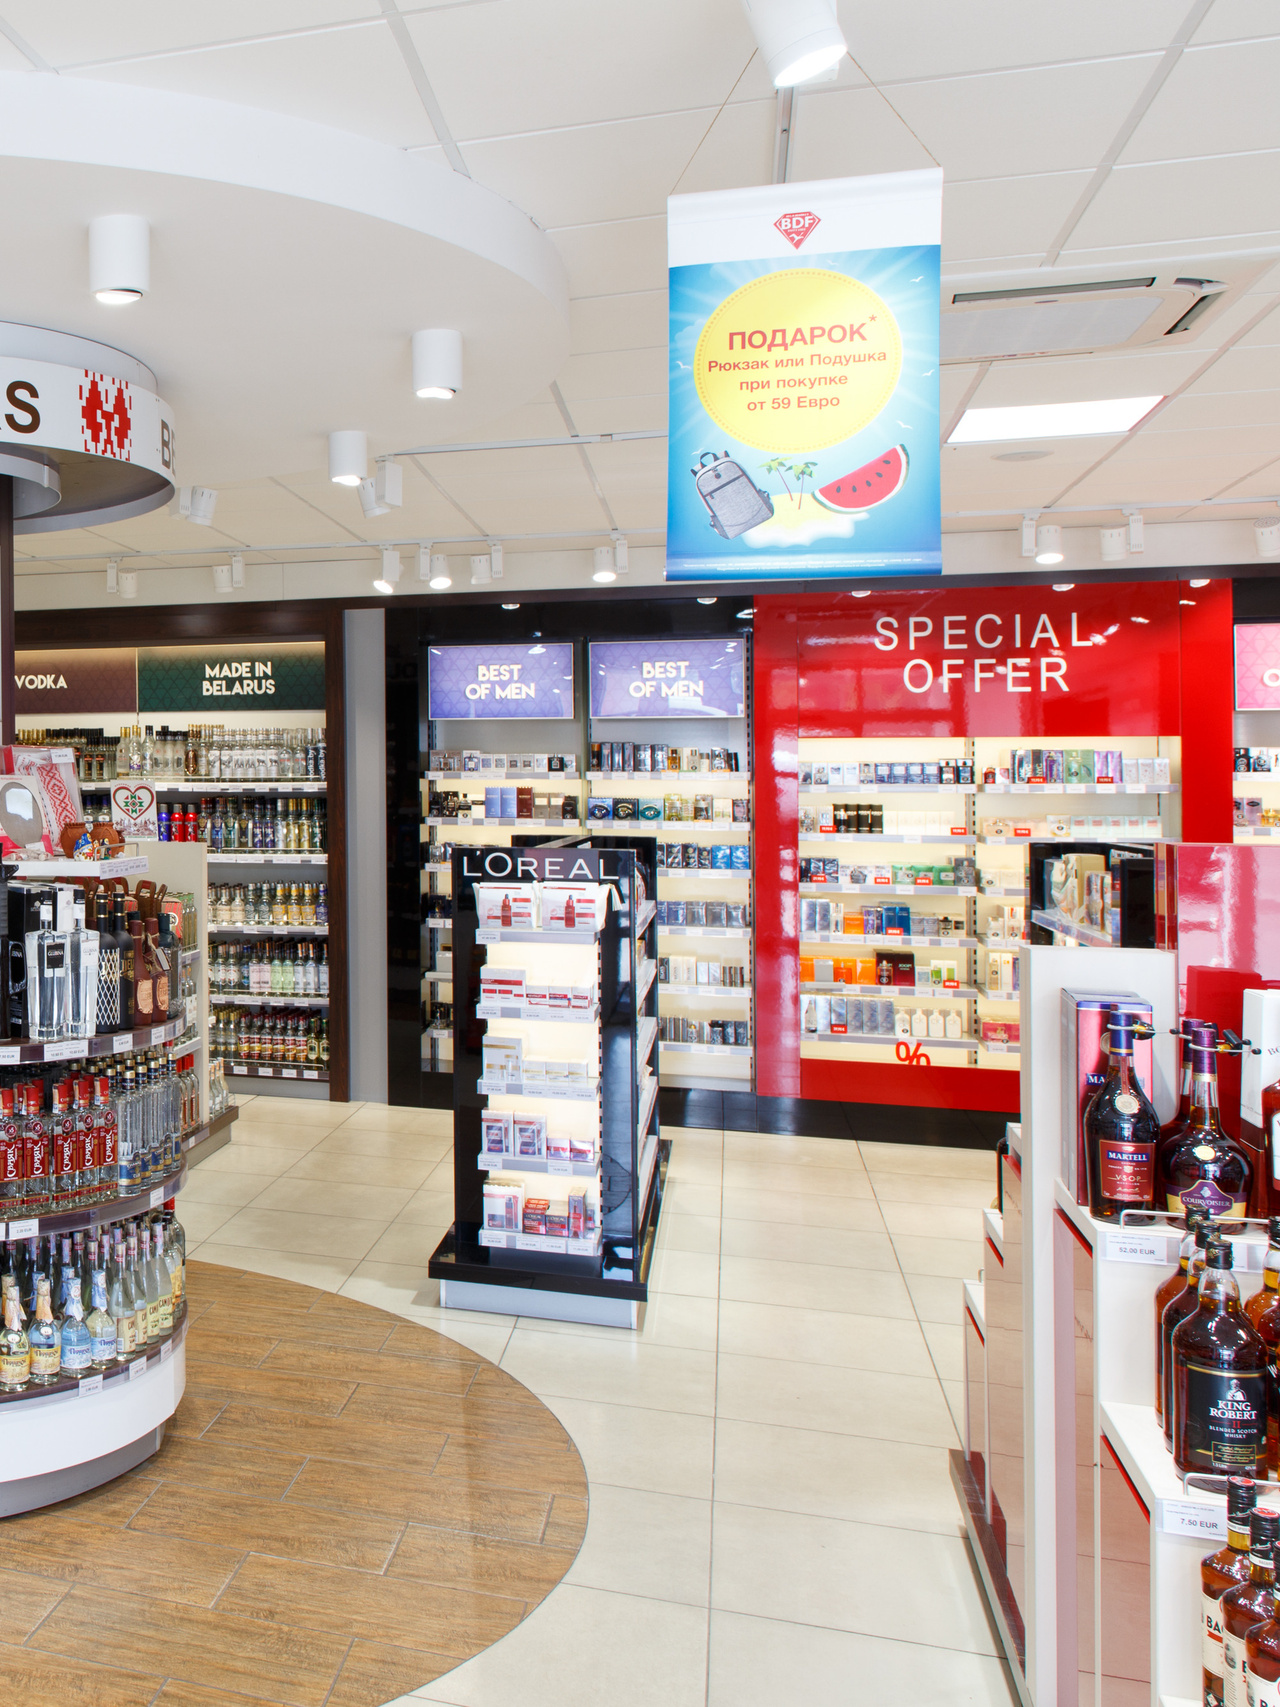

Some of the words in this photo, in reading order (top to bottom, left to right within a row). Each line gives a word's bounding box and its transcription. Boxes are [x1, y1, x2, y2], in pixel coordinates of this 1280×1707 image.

[780, 216, 814, 230] BDF
[708, 359, 769, 372] Рюкзак
[775, 357, 804, 368] или
[810, 351, 887, 366] Подушка
[739, 379, 770, 392] при
[776, 375, 848, 390] покупке
[747, 400, 766, 411] от
[771, 397, 791, 410] 59
[797, 396, 840, 409] Евро
[874, 611, 1094, 651] SPECIAL
[204, 662, 251, 679] MADE
[255, 661, 272, 677] IN
[477, 664, 522, 682] BEST
[642, 661, 689, 679] BEST
[903, 656, 1071, 694] OFFER
[15, 674, 68, 690] VODKA
[202, 679, 276, 696] BELARUS
[629, 681, 656, 698] OF
[663, 680, 704, 698] MEN
[465, 684, 491, 700] OF
[495, 683, 536, 700] MEN
[463, 850, 620, 880] L'OREAL
[1108, 1152, 1148, 1161] MARTELL
[1182, 1197, 1231, 1207] COURVOISIER
[1139, 1248, 1156, 1256] EUR
[1209, 1407, 1257, 1420] ROBERT
[1217, 1400, 1251, 1411] KING
[1209, 1425, 1235, 1434] BLENDED
[1232, 1420, 1241, 1429] II
[1199, 1520, 1219, 1530] EUR
